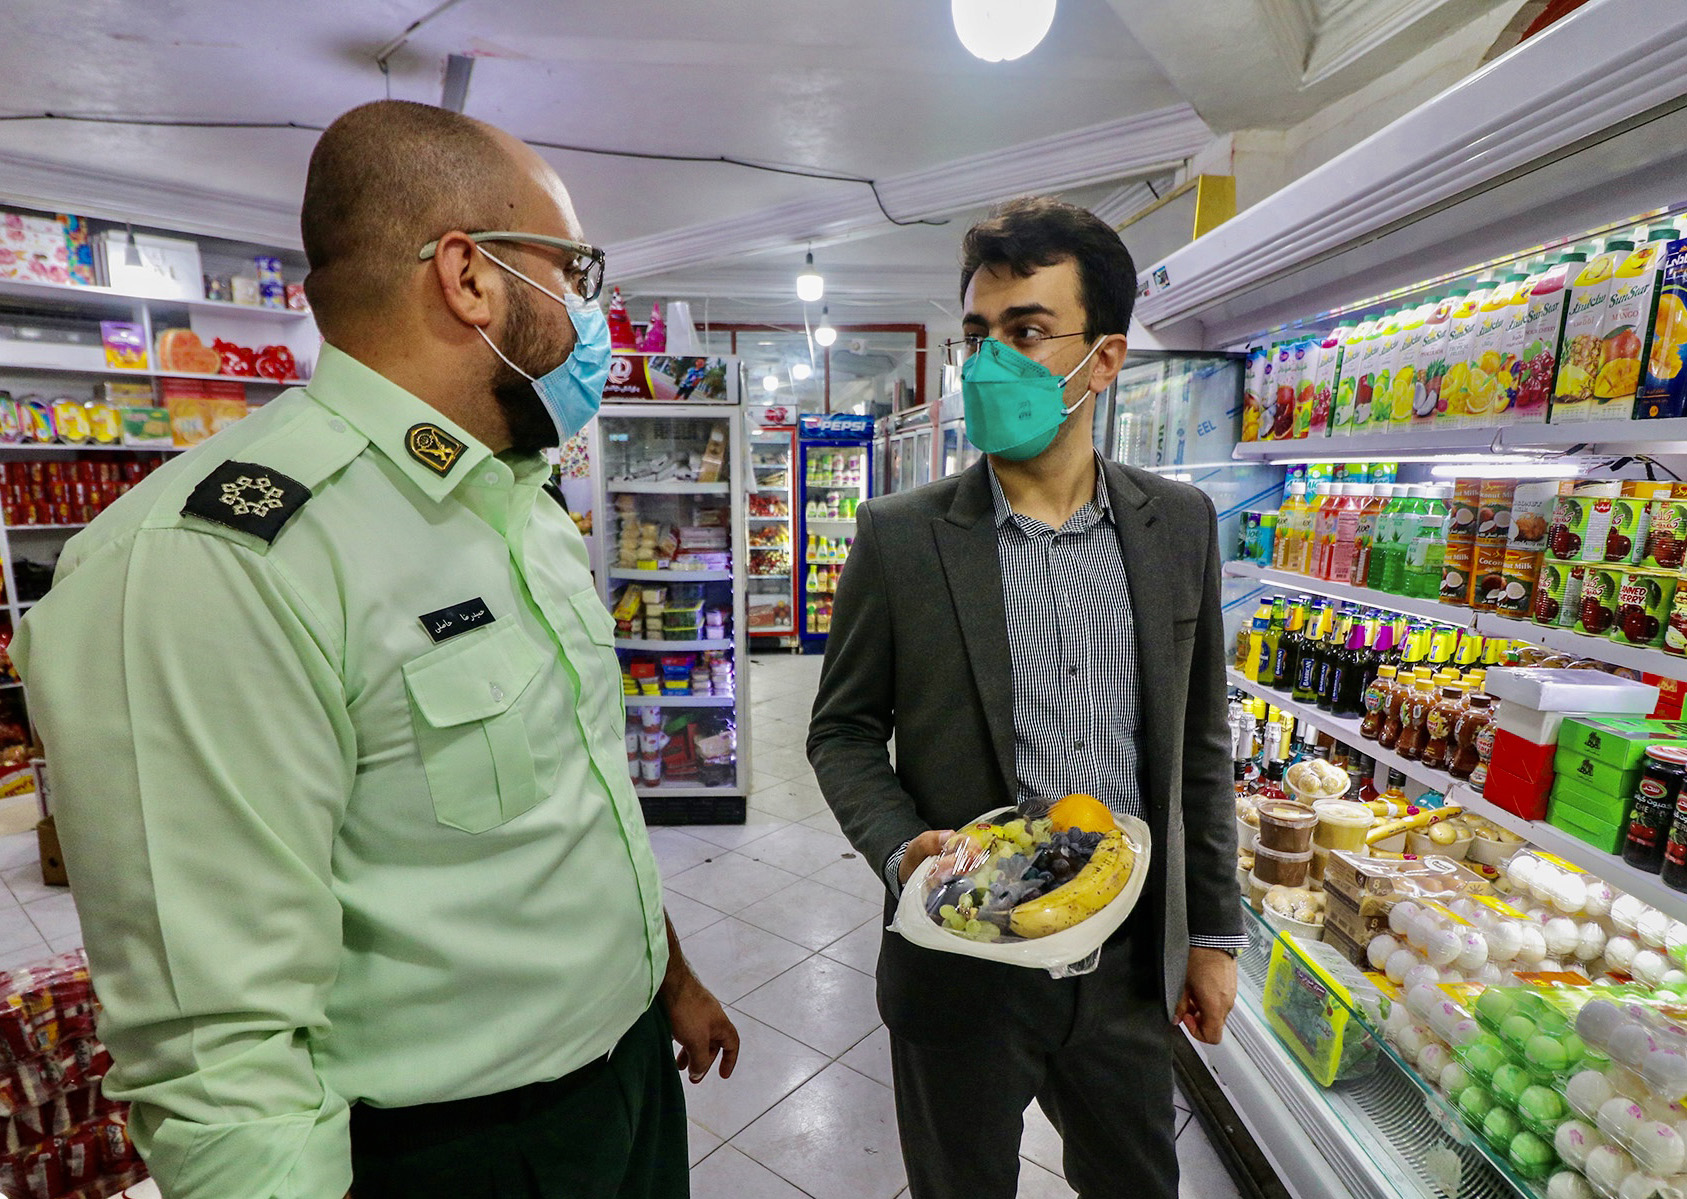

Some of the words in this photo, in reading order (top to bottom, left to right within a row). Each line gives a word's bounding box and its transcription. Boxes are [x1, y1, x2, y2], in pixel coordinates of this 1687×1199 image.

[1611, 310, 1639, 322] MANGO
[821, 421, 867, 431] PEPSI
[1479, 557, 1502, 567] Cocon
[1514, 562, 1533, 570] Milk
[1621, 585, 1647, 596] ANNED
[1620, 594, 1646, 605] ERRY
[1373, 879, 1380, 889] 8
[1372, 918, 1379, 928] 8
